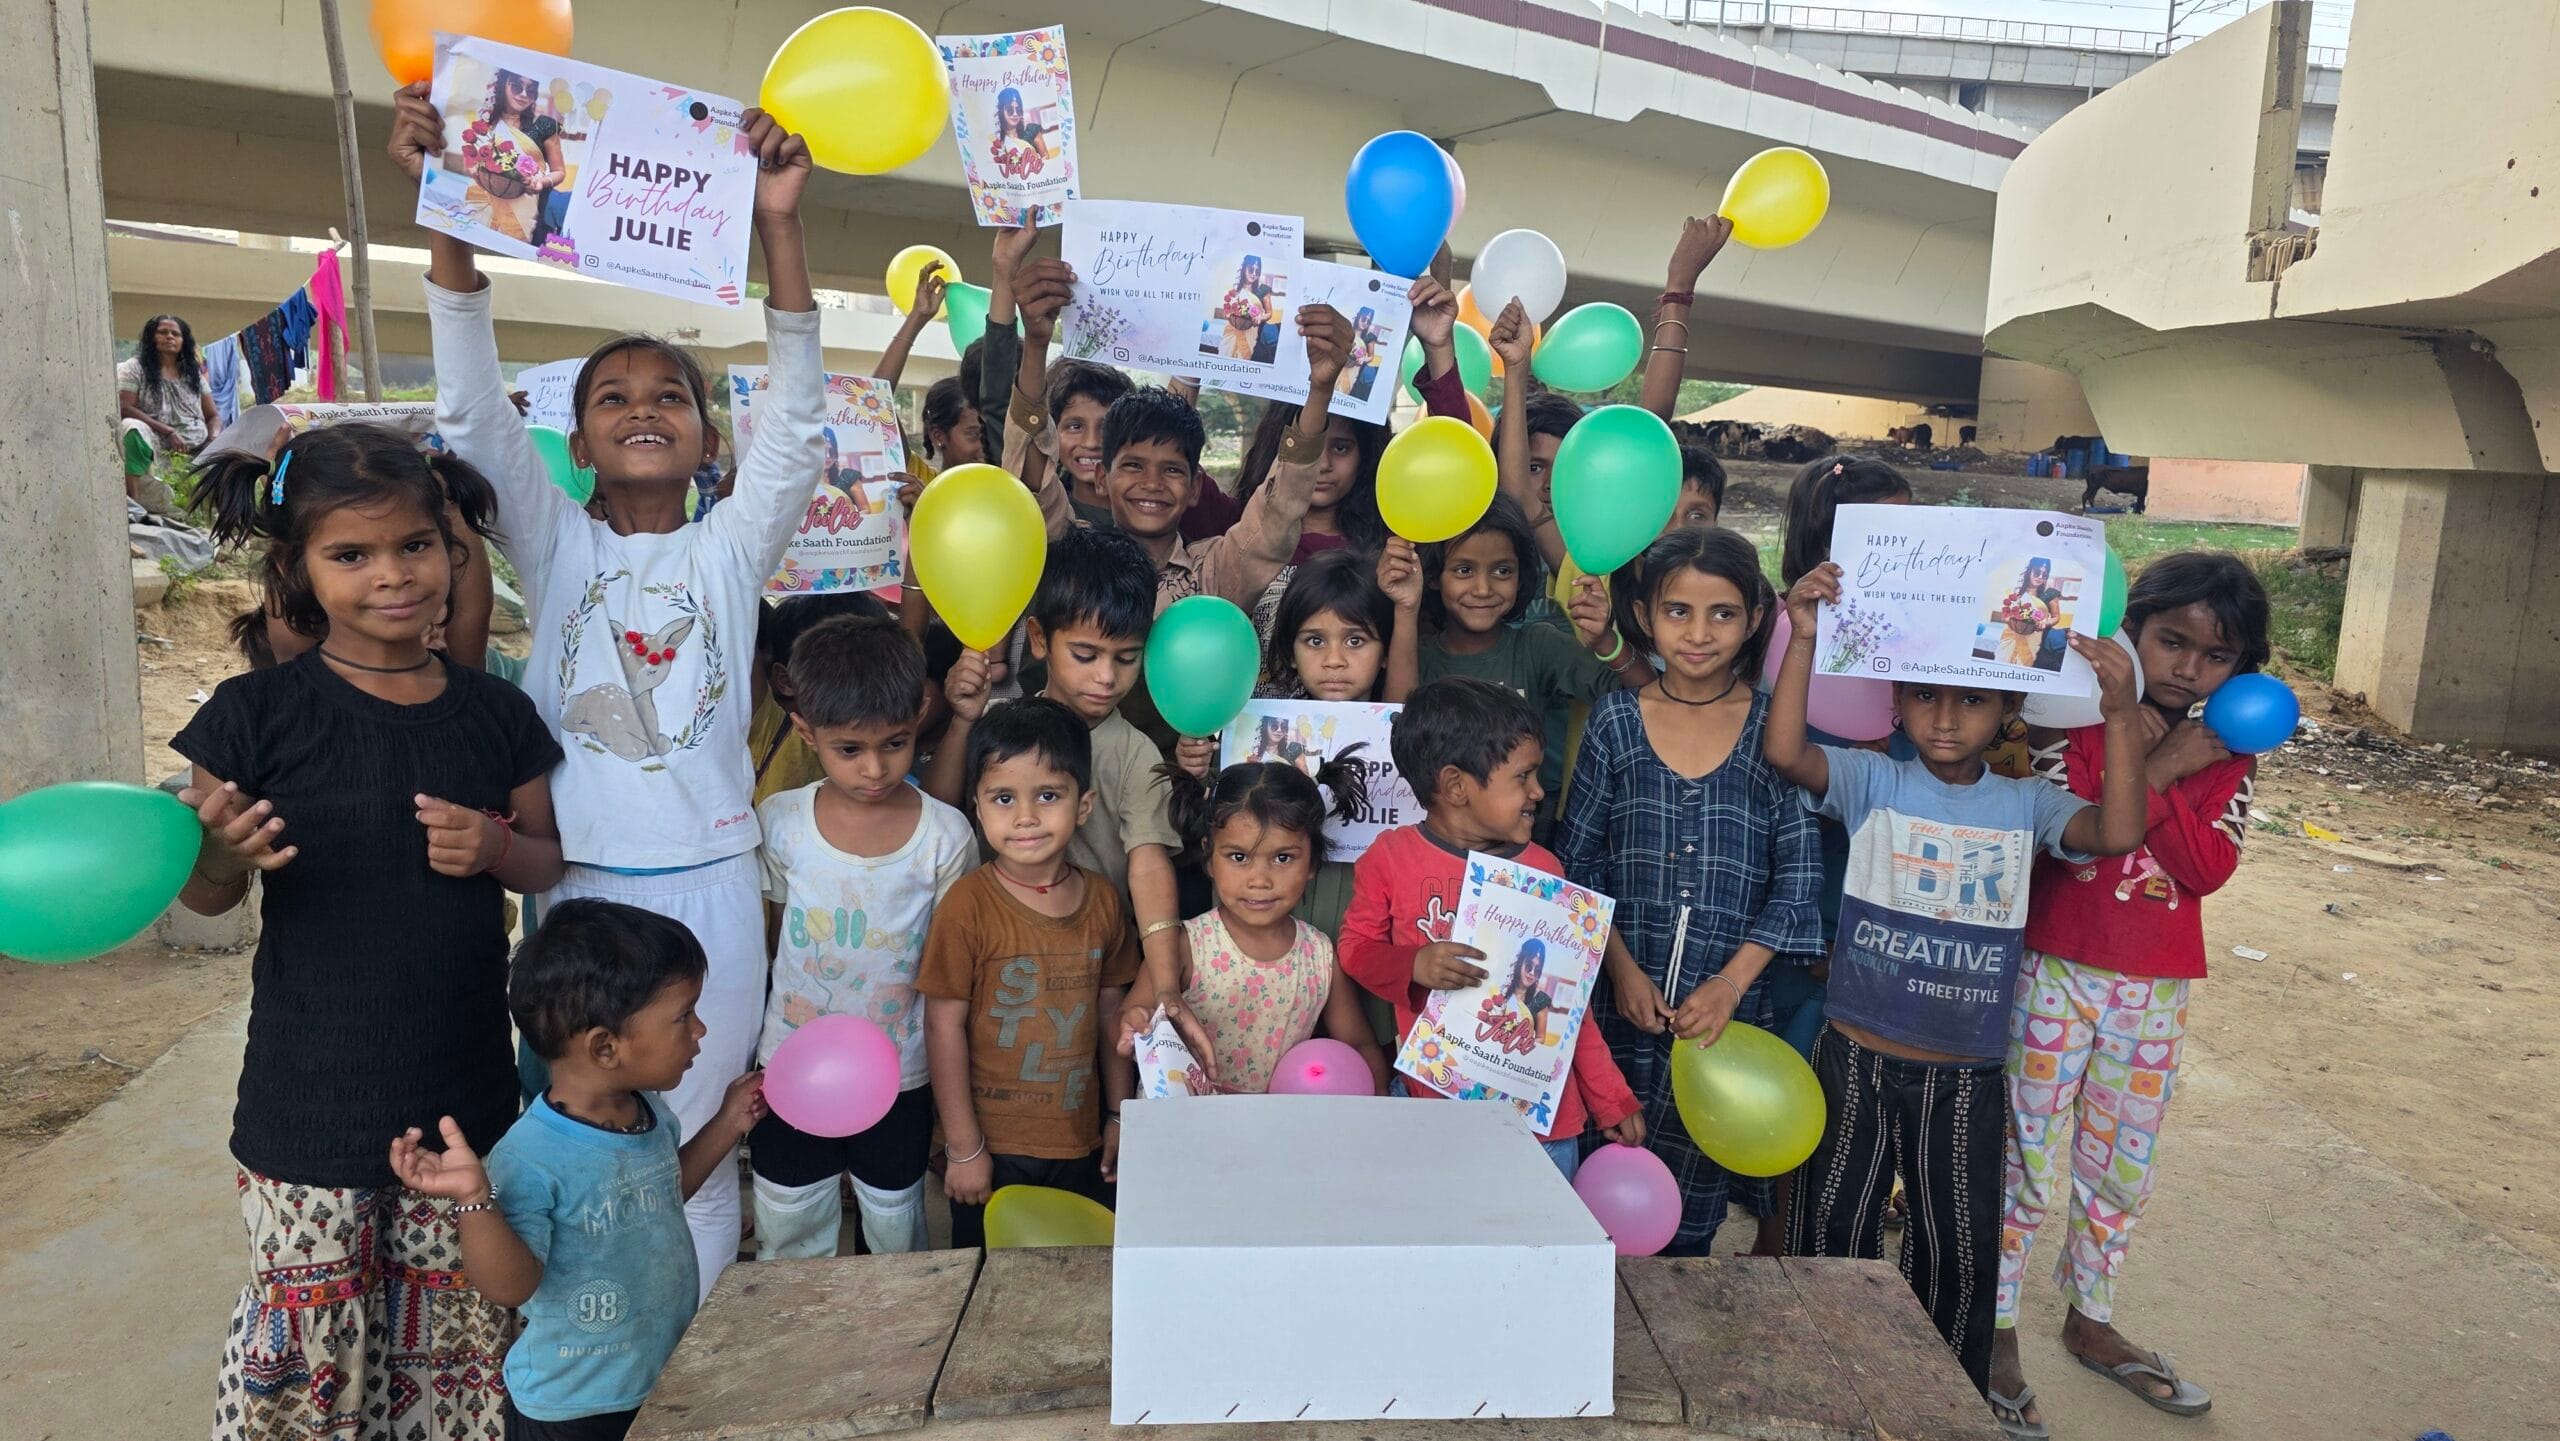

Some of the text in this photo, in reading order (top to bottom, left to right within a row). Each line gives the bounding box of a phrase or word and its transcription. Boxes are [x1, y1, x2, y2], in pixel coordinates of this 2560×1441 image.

[962, 65, 1053, 93] Happy Birthday
[609, 153, 712, 193] HAPPY
[1027, 175, 1068, 191] Foundation
[586, 169, 732, 237] Birthday
[609, 216, 692, 251] JULIE
[1100, 231, 1138, 244] HAPPY
[1093, 235, 1207, 286] Birthday!
[606, 261, 712, 291] @AapkeSaathFoundation
[1100, 287, 1201, 301] WISH YOU ALL THE BEST!
[1138, 352, 1262, 375] @AapkeSaathFoundation
[309, 406, 436, 420] Aapke Saath Foundatio
[826, 406, 879, 434] irthday
[803, 537, 833, 548] Saath
[835, 535, 892, 547] Foundation
[1867, 534, 1908, 548] HAPPY
[1856, 538, 1987, 589] Birthday!
[1864, 590, 1976, 605] WISH YOU ALL THE BEST!
[1901, 661, 2045, 683] @AapkeSaathFoundation
[1952, 827, 2008, 843] GREAT
[1959, 864, 1974, 883] THE
[1961, 908, 1975, 919] 78
[1484, 903, 1587, 961] Happy Birthday
[1853, 918, 2006, 974] CREATIVE
[1847, 946, 1900, 977] BROOKLYN
[1475, 1014, 1536, 1056] Julie
[1438, 1027, 1552, 1083] Aapke Saath Foundation
[578, 1290, 619, 1322] 98
[559, 1341, 631, 1358] DIVISION
